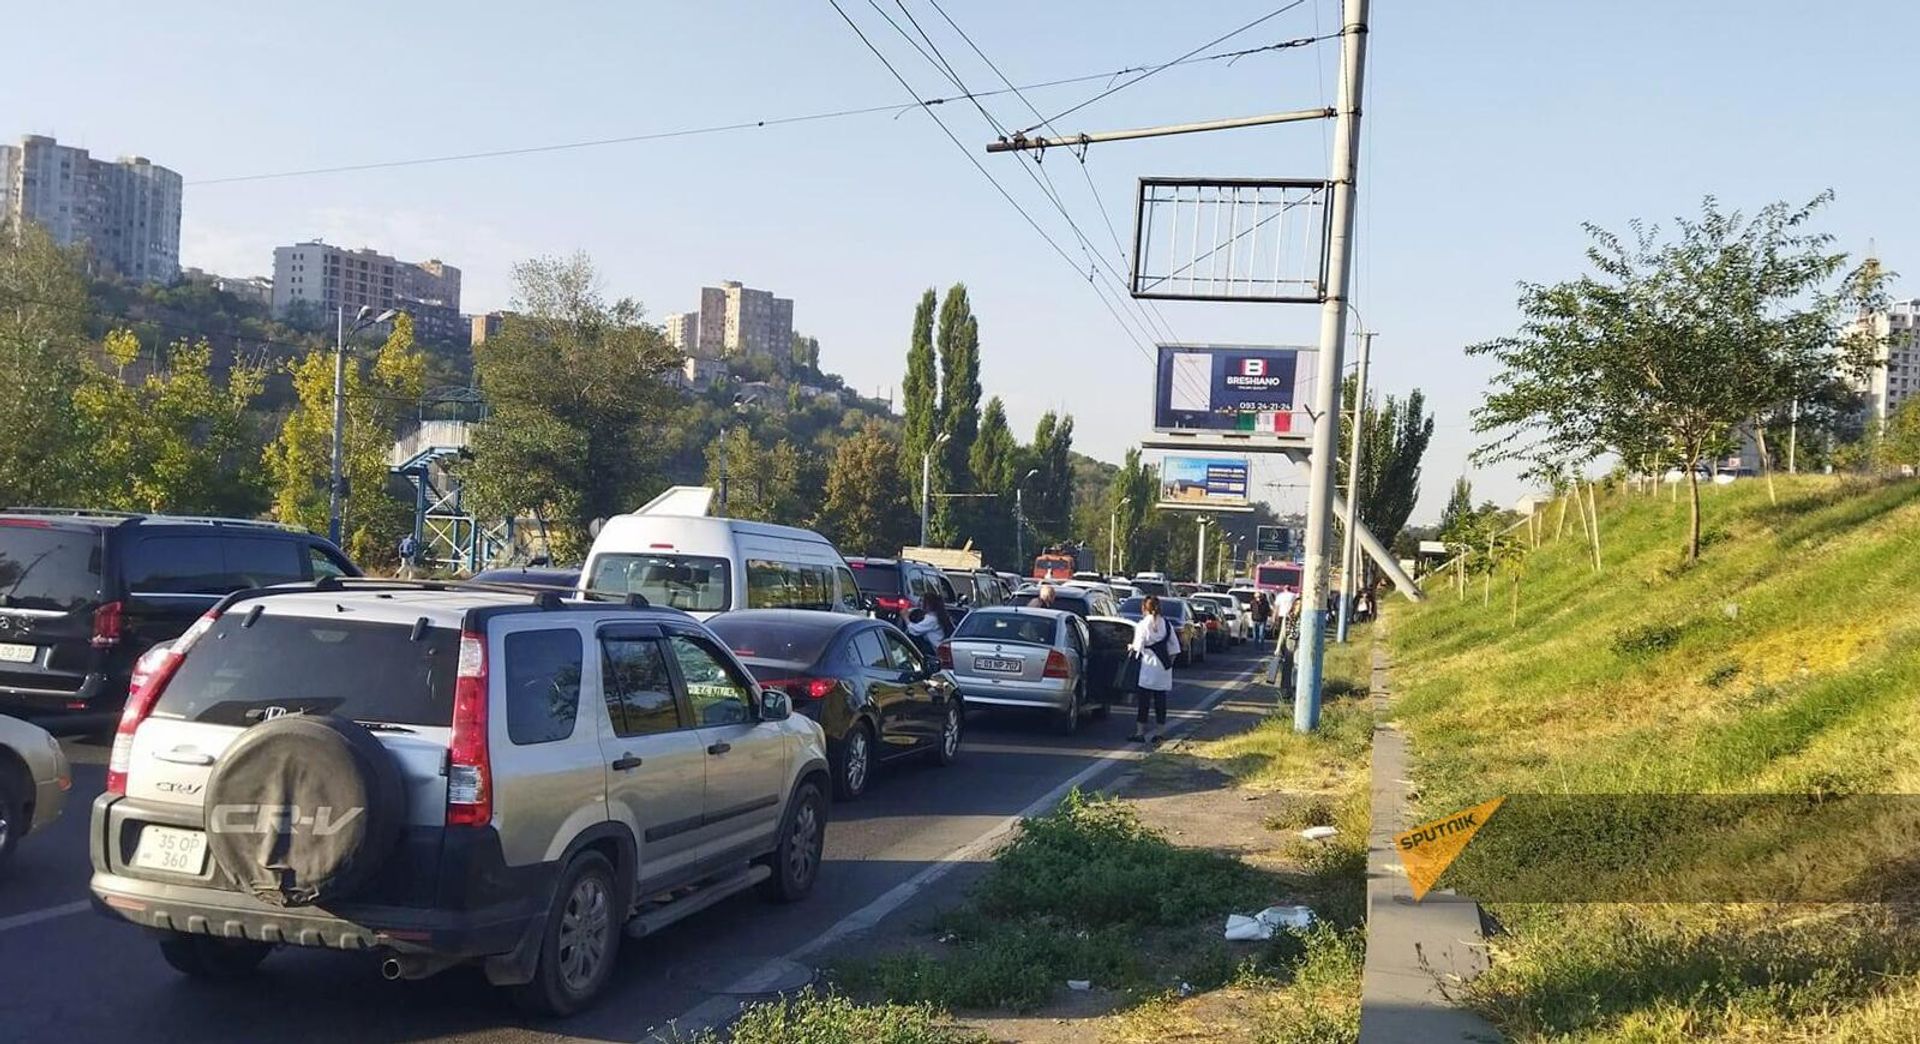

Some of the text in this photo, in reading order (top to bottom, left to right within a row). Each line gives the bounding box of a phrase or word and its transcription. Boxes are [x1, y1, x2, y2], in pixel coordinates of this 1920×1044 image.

[1244, 358, 1264, 376] B
[1226, 376, 1280, 386] BRESHIANO
[210, 803, 366, 836] CR-V
[157, 833, 177, 850] 35
[161, 850, 189, 868] 360
